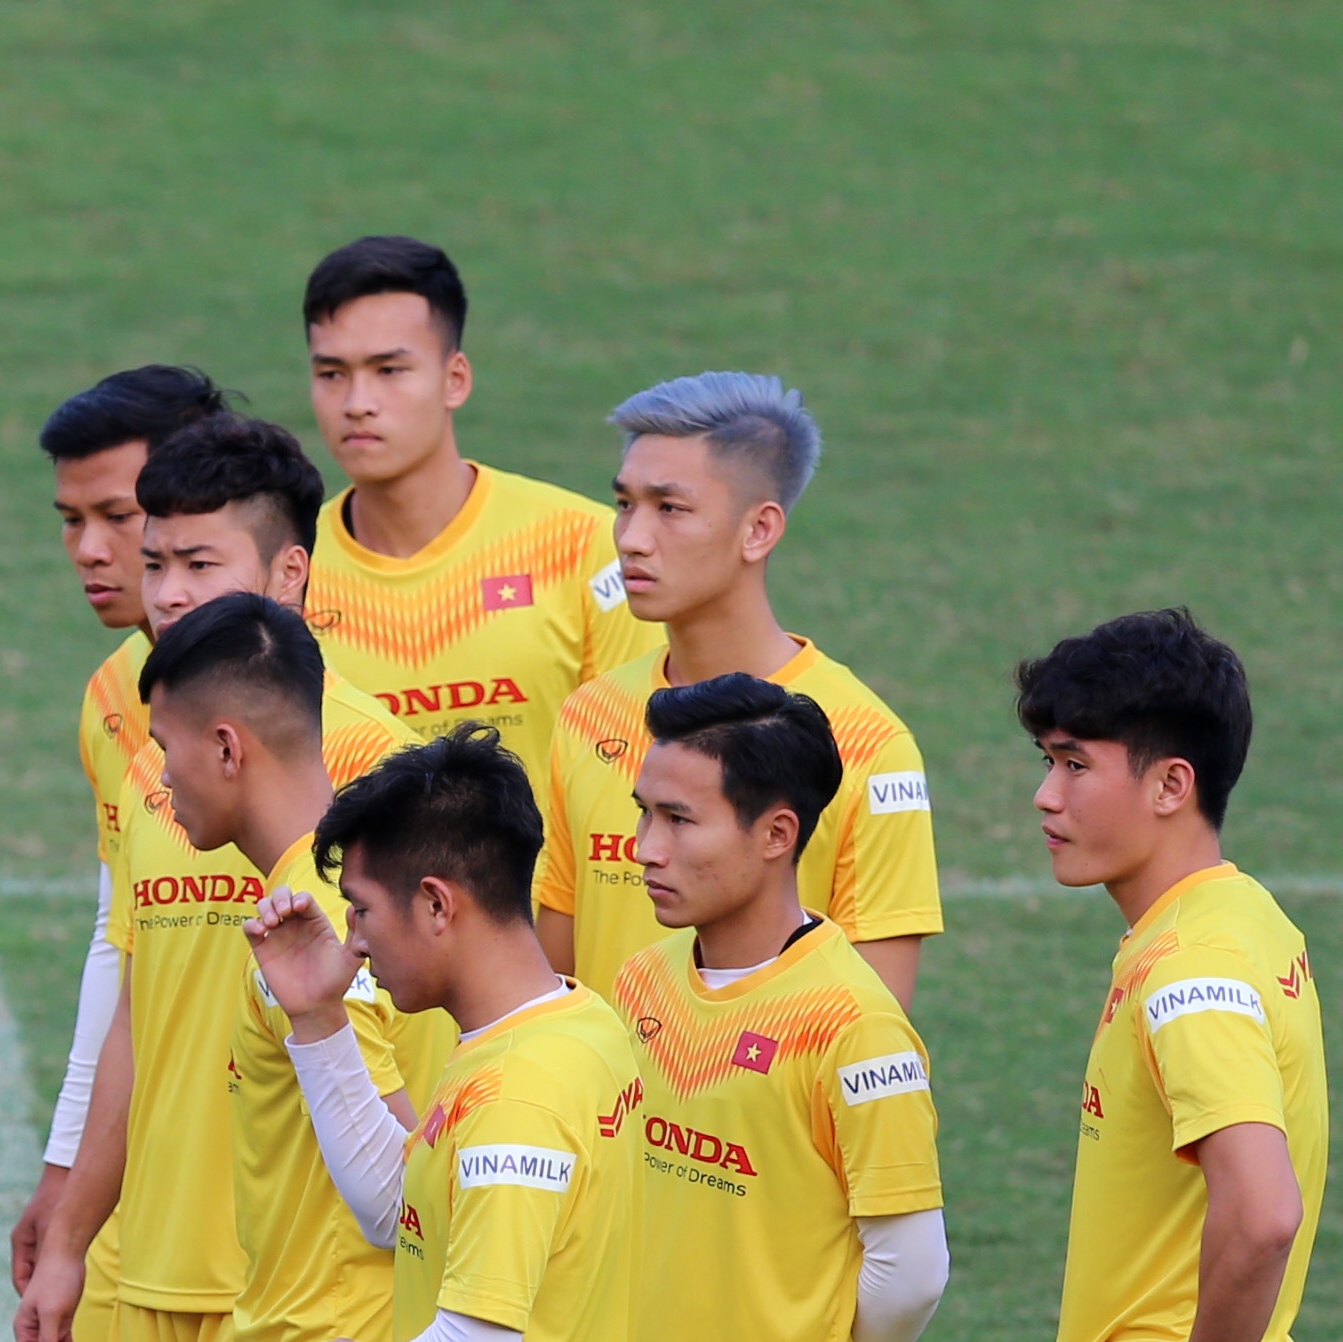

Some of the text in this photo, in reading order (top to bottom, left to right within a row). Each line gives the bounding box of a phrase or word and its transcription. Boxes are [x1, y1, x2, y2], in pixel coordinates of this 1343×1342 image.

[593, 869, 619, 884] The
[133, 875, 264, 910] HONDA
[461, 1153, 572, 1185] VINAMILK
[689, 1168, 747, 1198] Dreams
